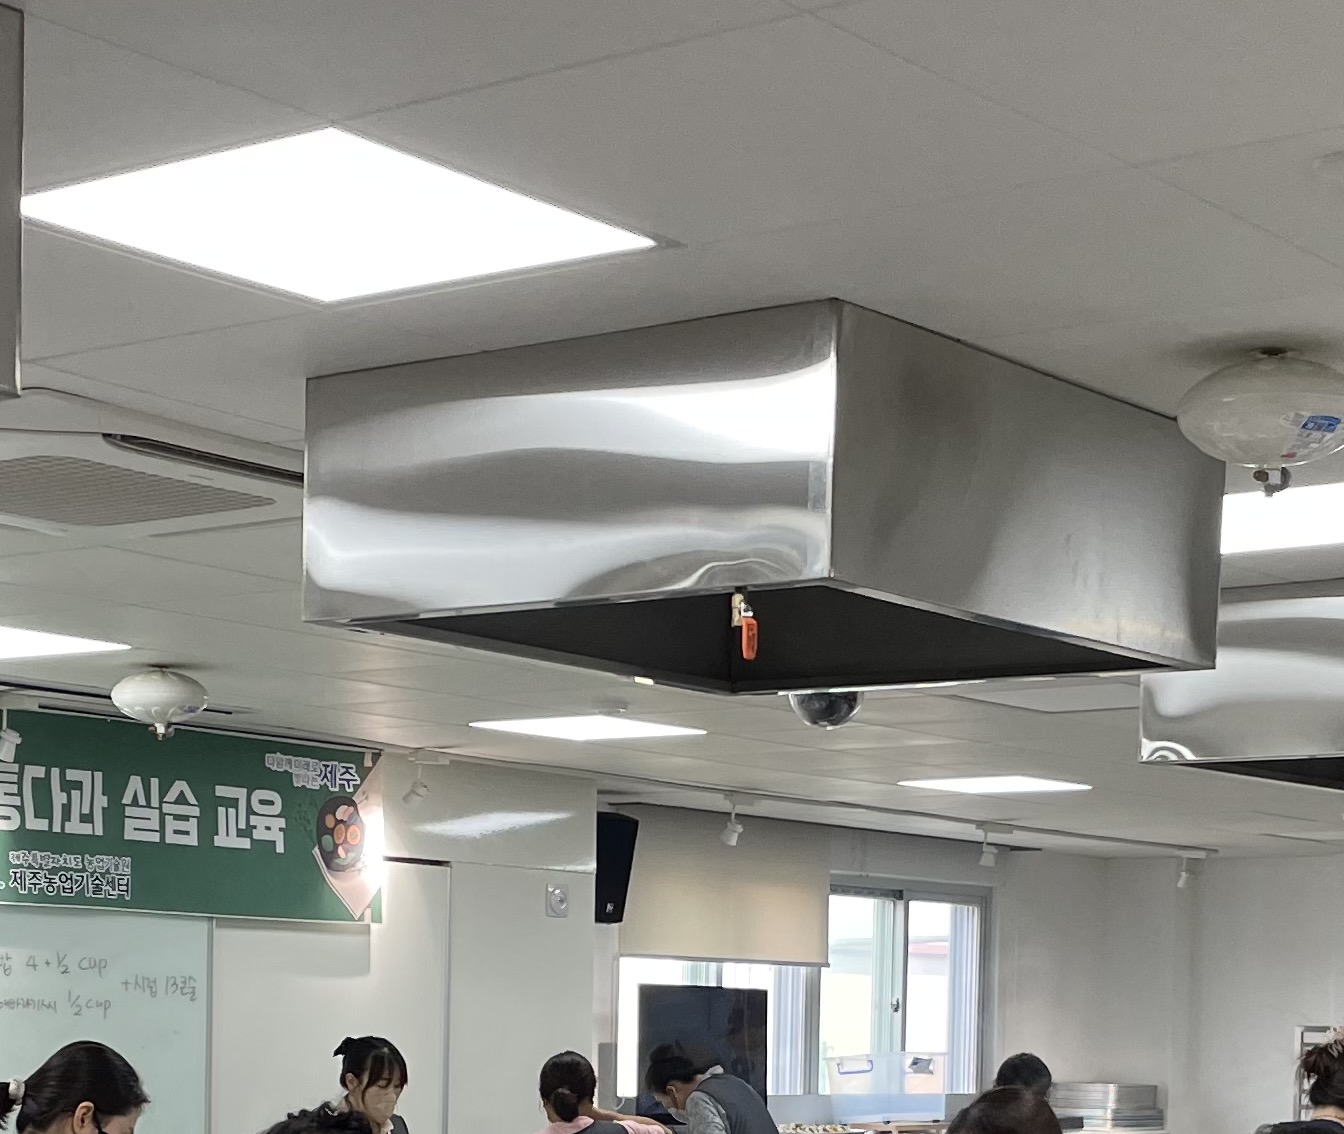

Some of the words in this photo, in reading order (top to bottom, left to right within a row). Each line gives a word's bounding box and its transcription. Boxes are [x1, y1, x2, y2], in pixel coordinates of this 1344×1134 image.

[320, 761, 359, 791] 제주
[122, 774, 201, 846] 실습
[213, 785, 286, 854] 교육
[9, 870, 132, 900] 제주농업기술센터
